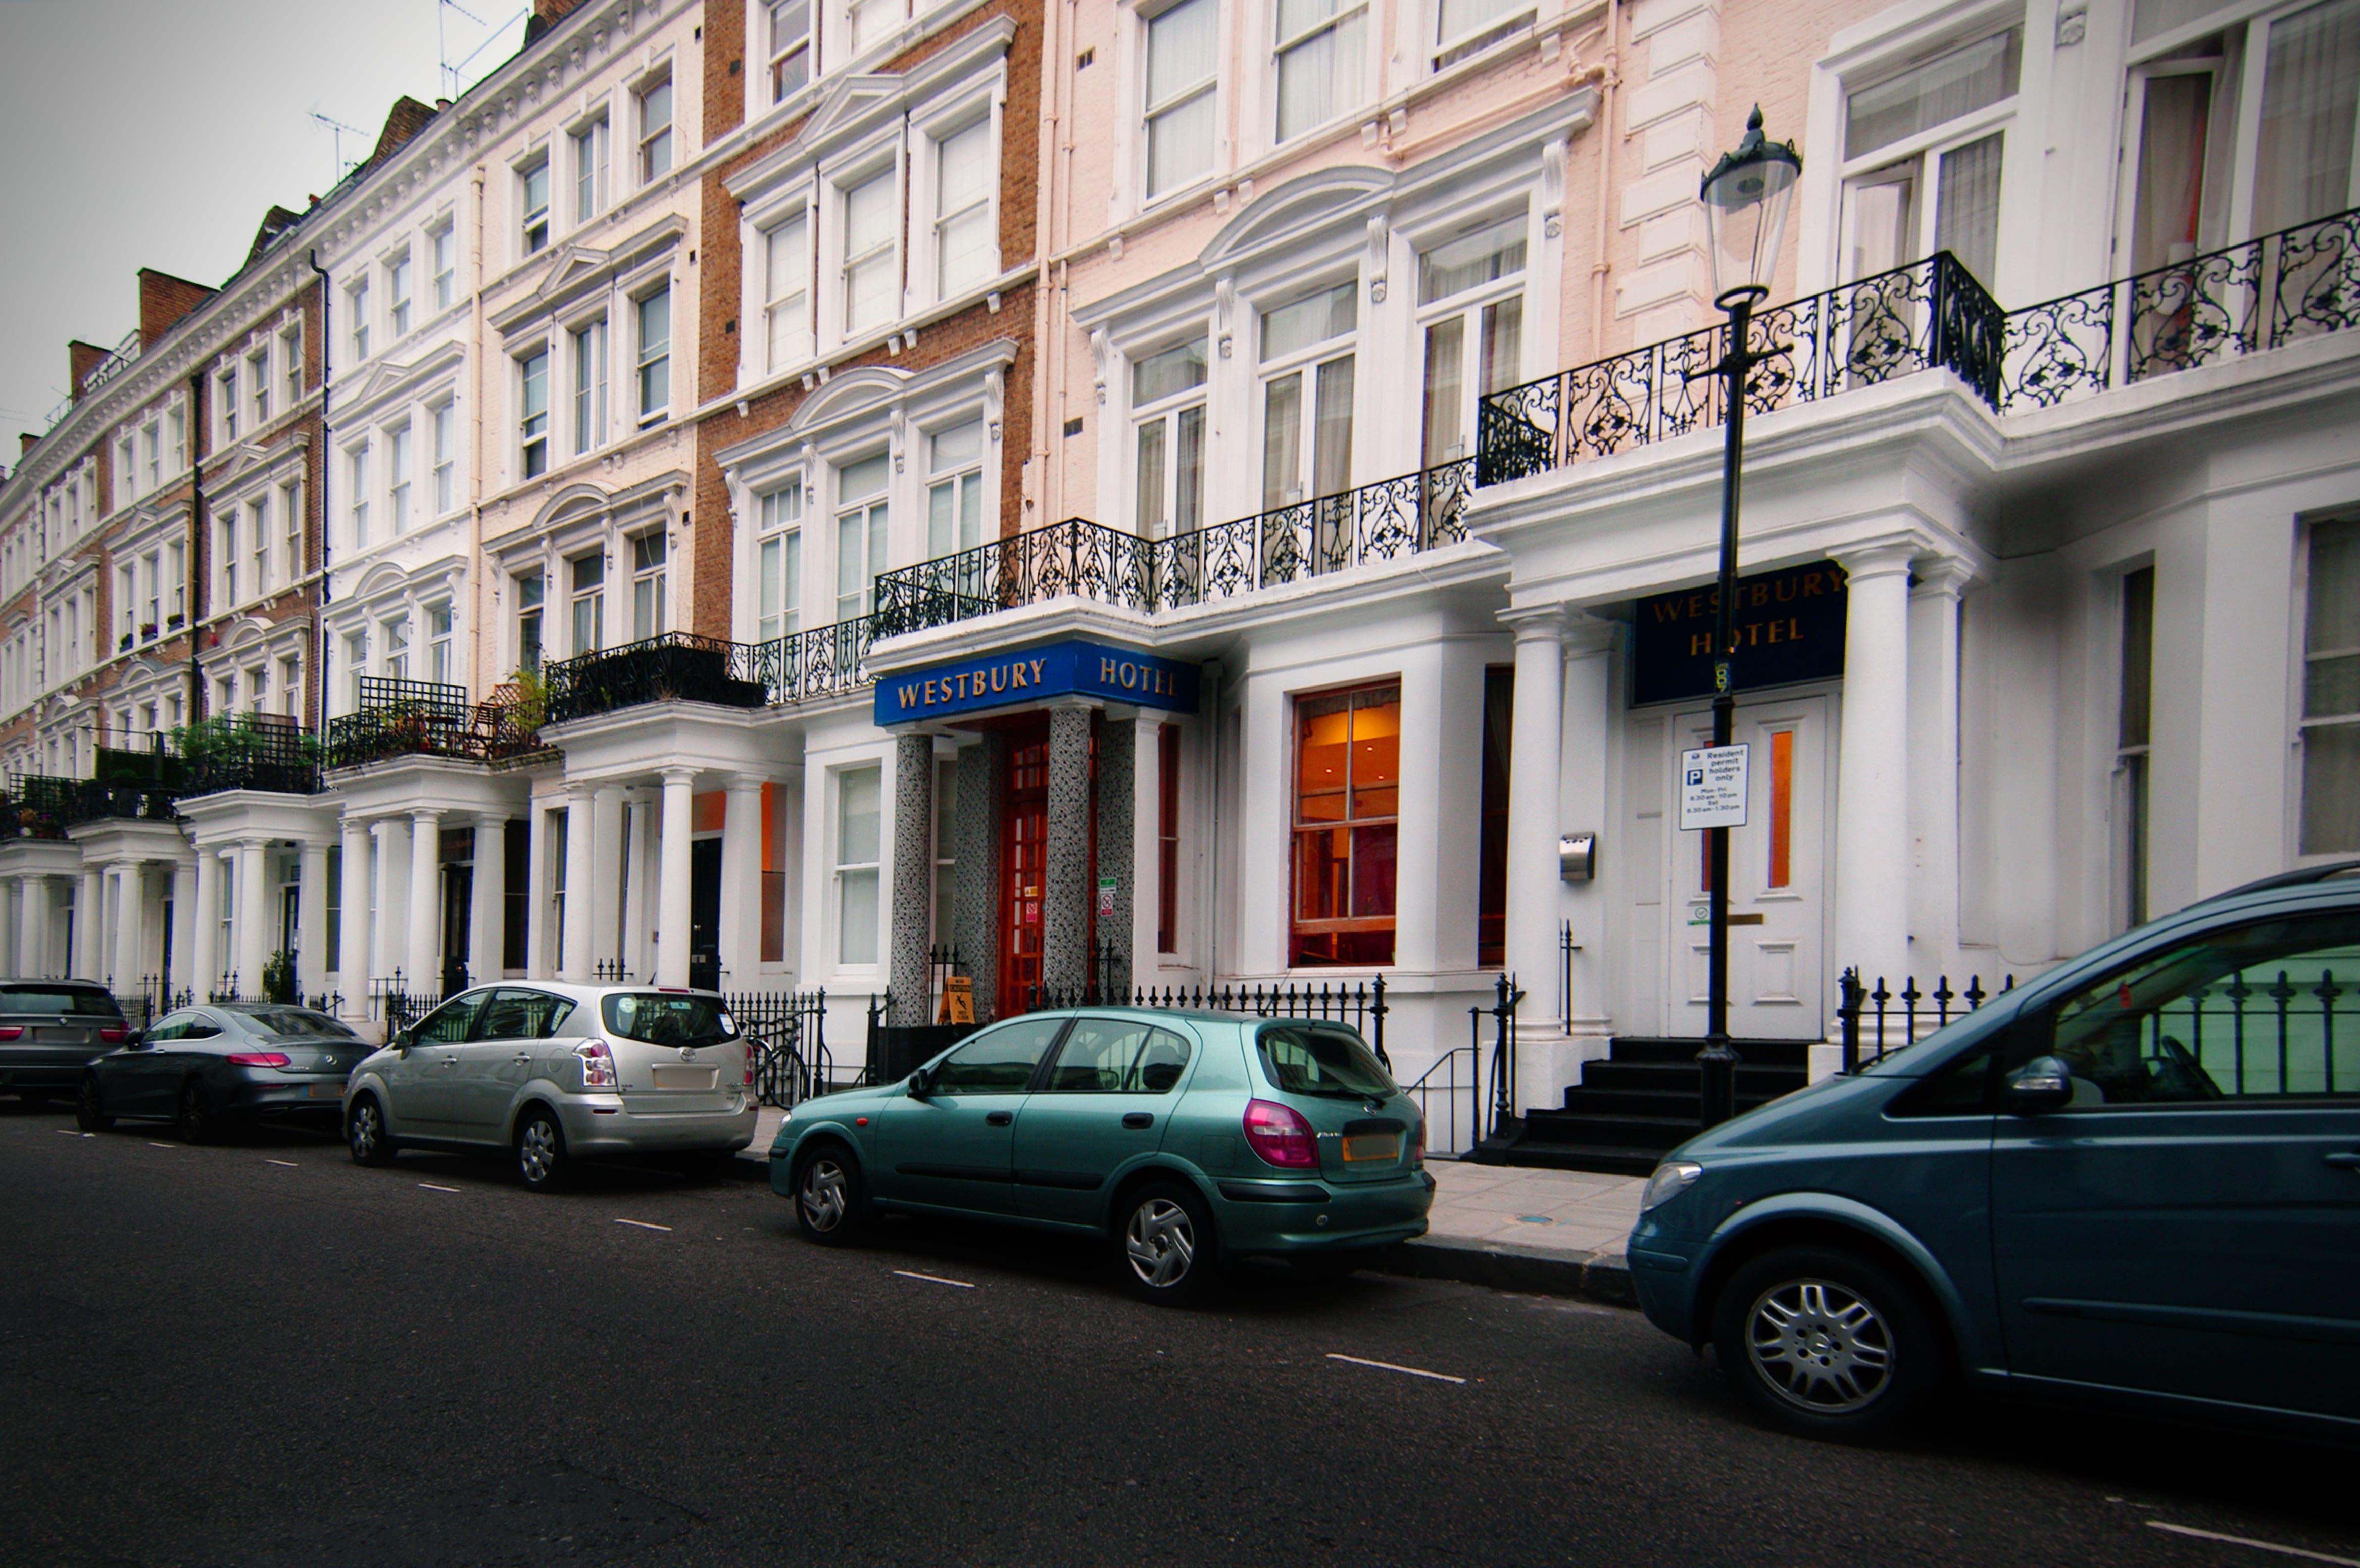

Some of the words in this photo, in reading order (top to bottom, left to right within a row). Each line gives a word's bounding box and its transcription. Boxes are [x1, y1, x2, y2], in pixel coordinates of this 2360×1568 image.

[1652, 569, 1846, 623] WESTBURY
[898, 658, 1047, 709] WESTBURY
[1100, 657, 1178, 697] HOTEL
[1707, 750, 1744, 759] Resident
[1711, 758, 1739, 767] permit
[1690, 771, 1701, 785] P
